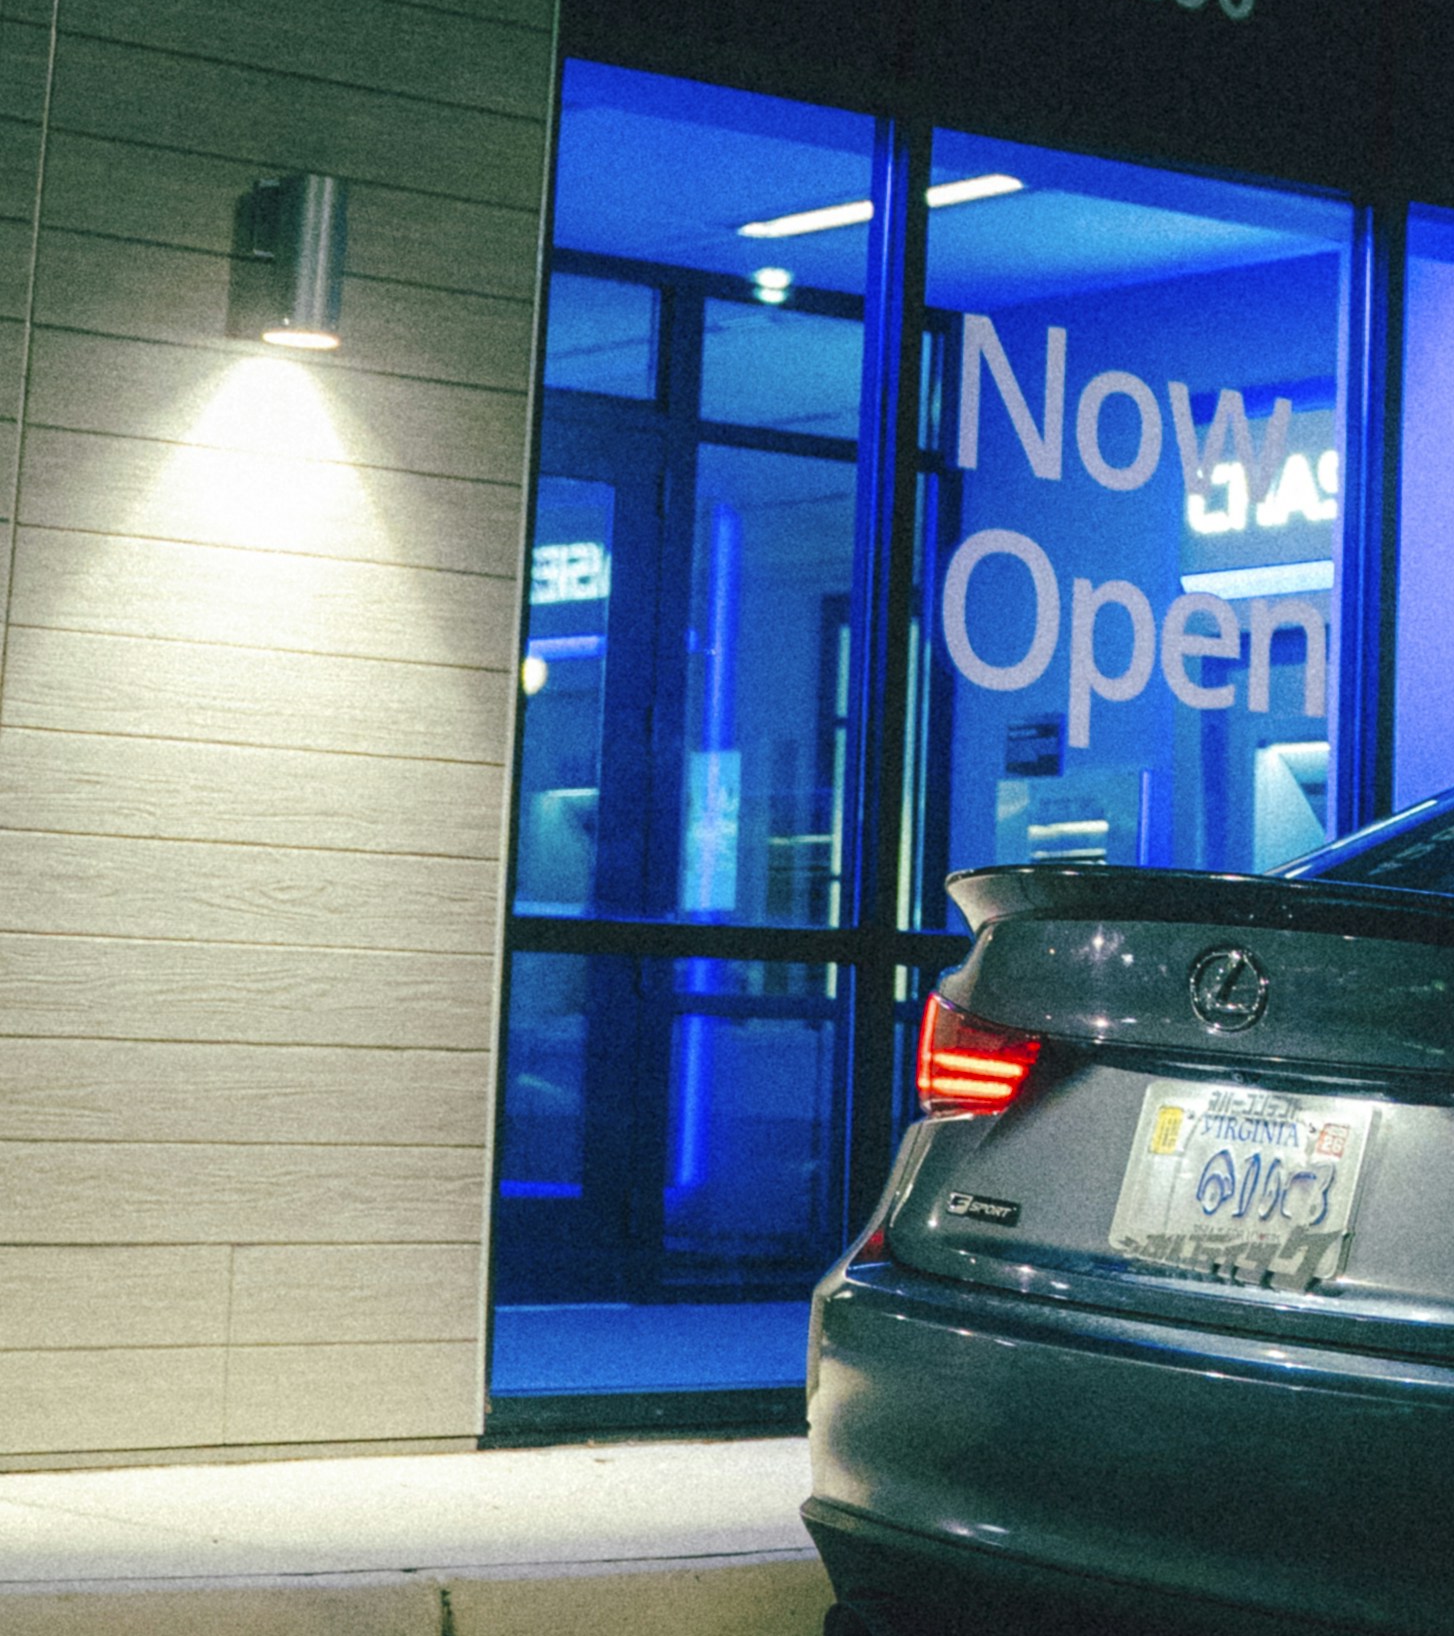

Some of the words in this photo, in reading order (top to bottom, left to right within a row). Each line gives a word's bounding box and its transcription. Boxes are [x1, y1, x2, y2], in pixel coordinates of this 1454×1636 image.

[957, 312, 1293, 502] Now
[942, 528, 1327, 748] Open
[1200, 1112, 1302, 1148] VIRGINIA
[969, 1201, 1012, 1218] SPORT
